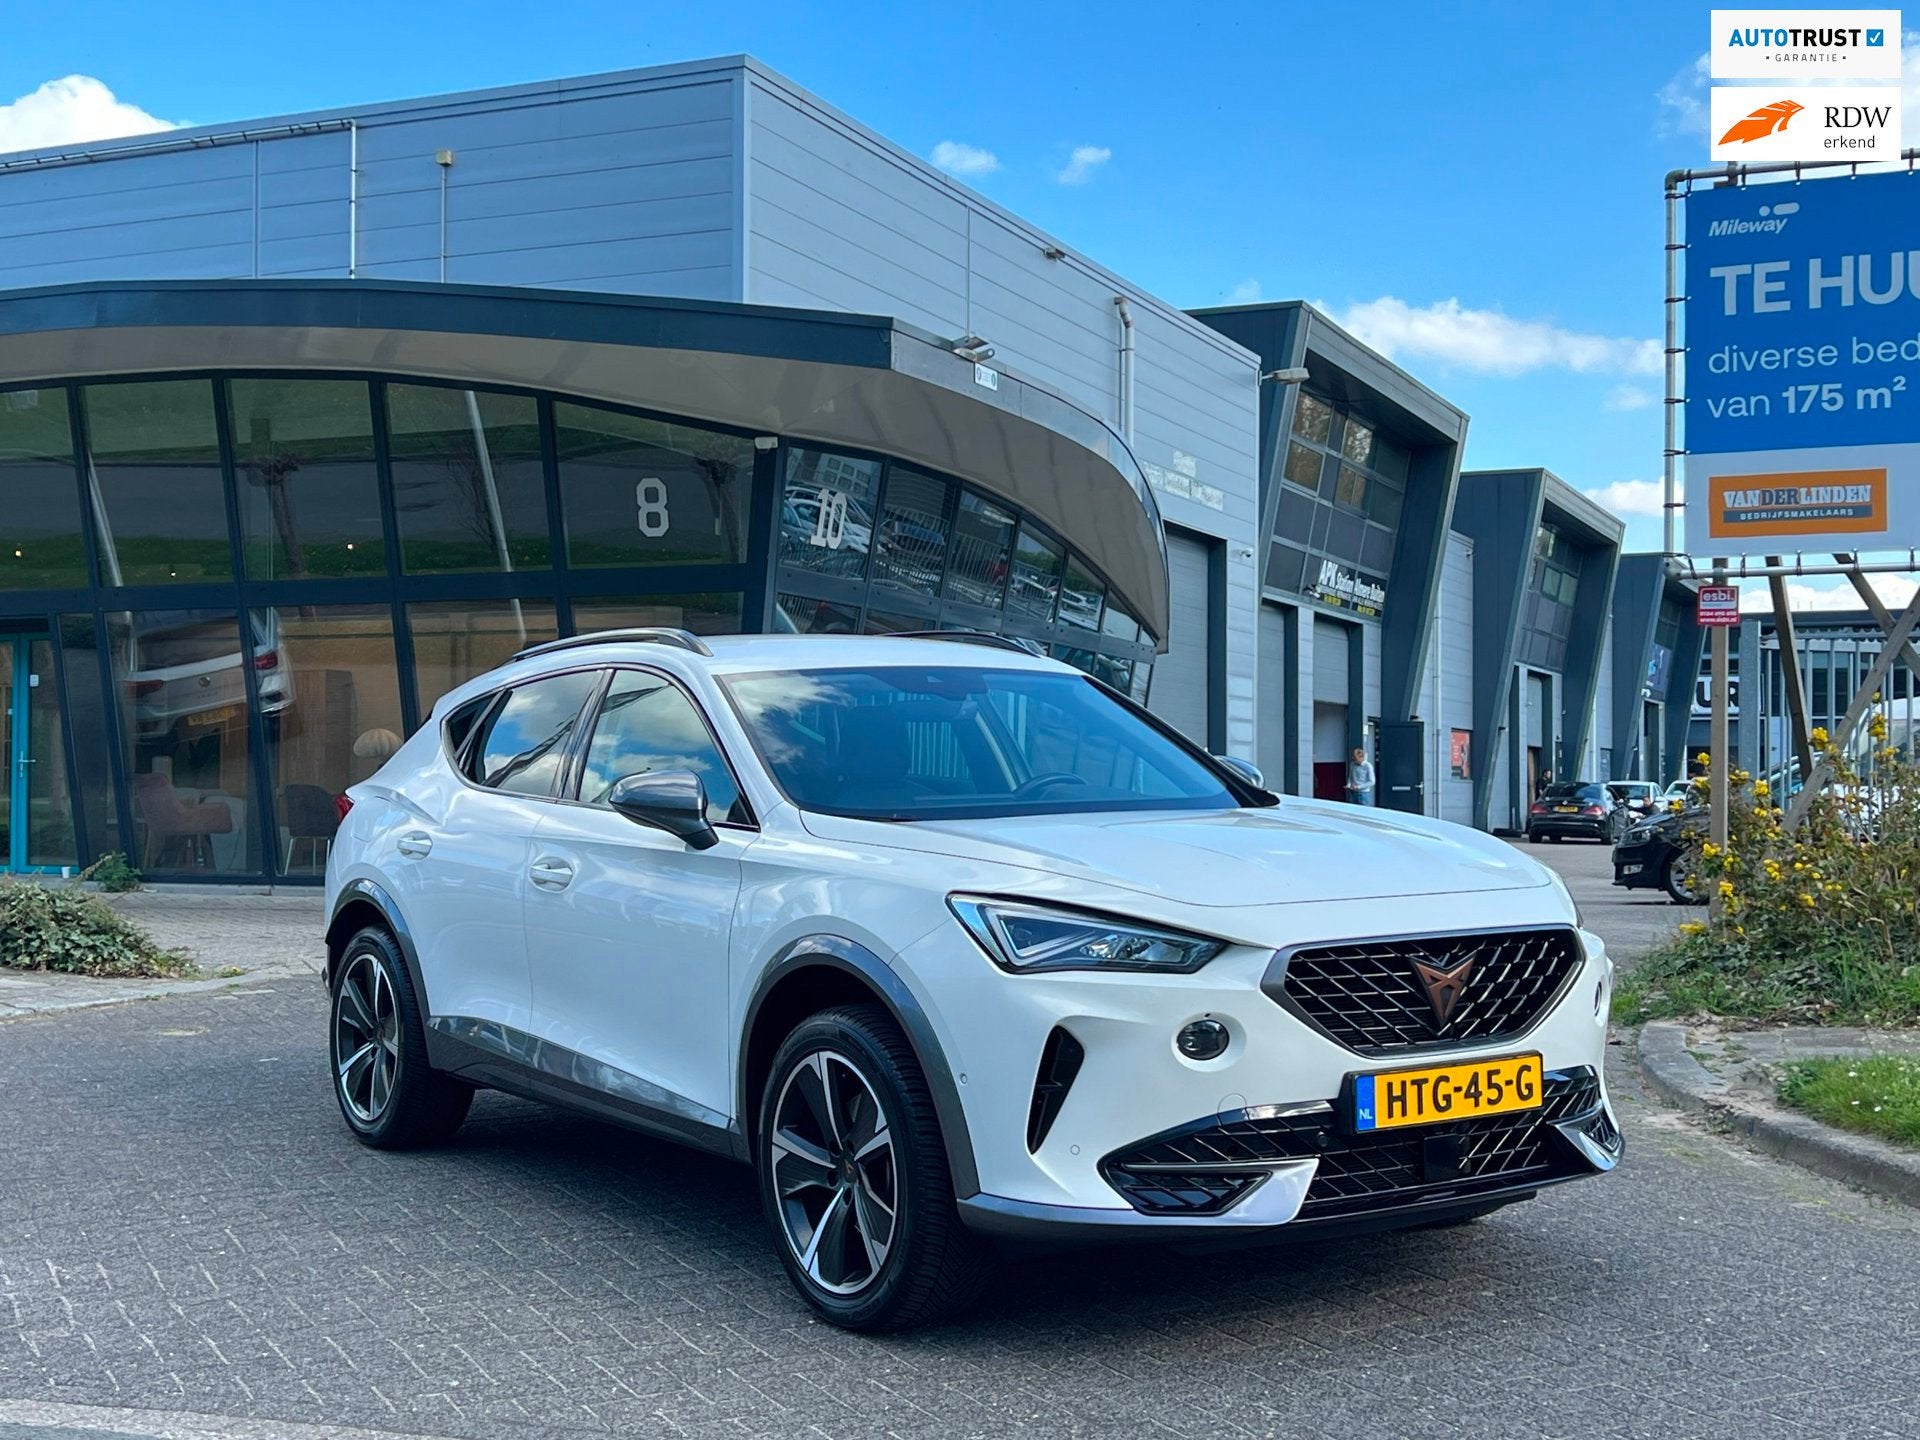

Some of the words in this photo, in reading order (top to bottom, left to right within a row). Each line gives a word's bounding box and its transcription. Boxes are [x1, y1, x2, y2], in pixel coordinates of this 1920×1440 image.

[1708, 218, 1788, 237] Mileway
[1709, 260, 1791, 316] TE
[1808, 250, 1920, 309] HU
[1708, 344, 1838, 374] diverse
[1707, 394, 1770, 419] van
[1782, 383, 1844, 414] 175
[636, 477, 670, 538] 8
[810, 488, 848, 550] 10
[1740, 509, 1853, 520] BEDRIJFSMAKELAARS
[1387, 1064, 1534, 1119] HTG-45-G
[1359, 1108, 1373, 1120] NL
